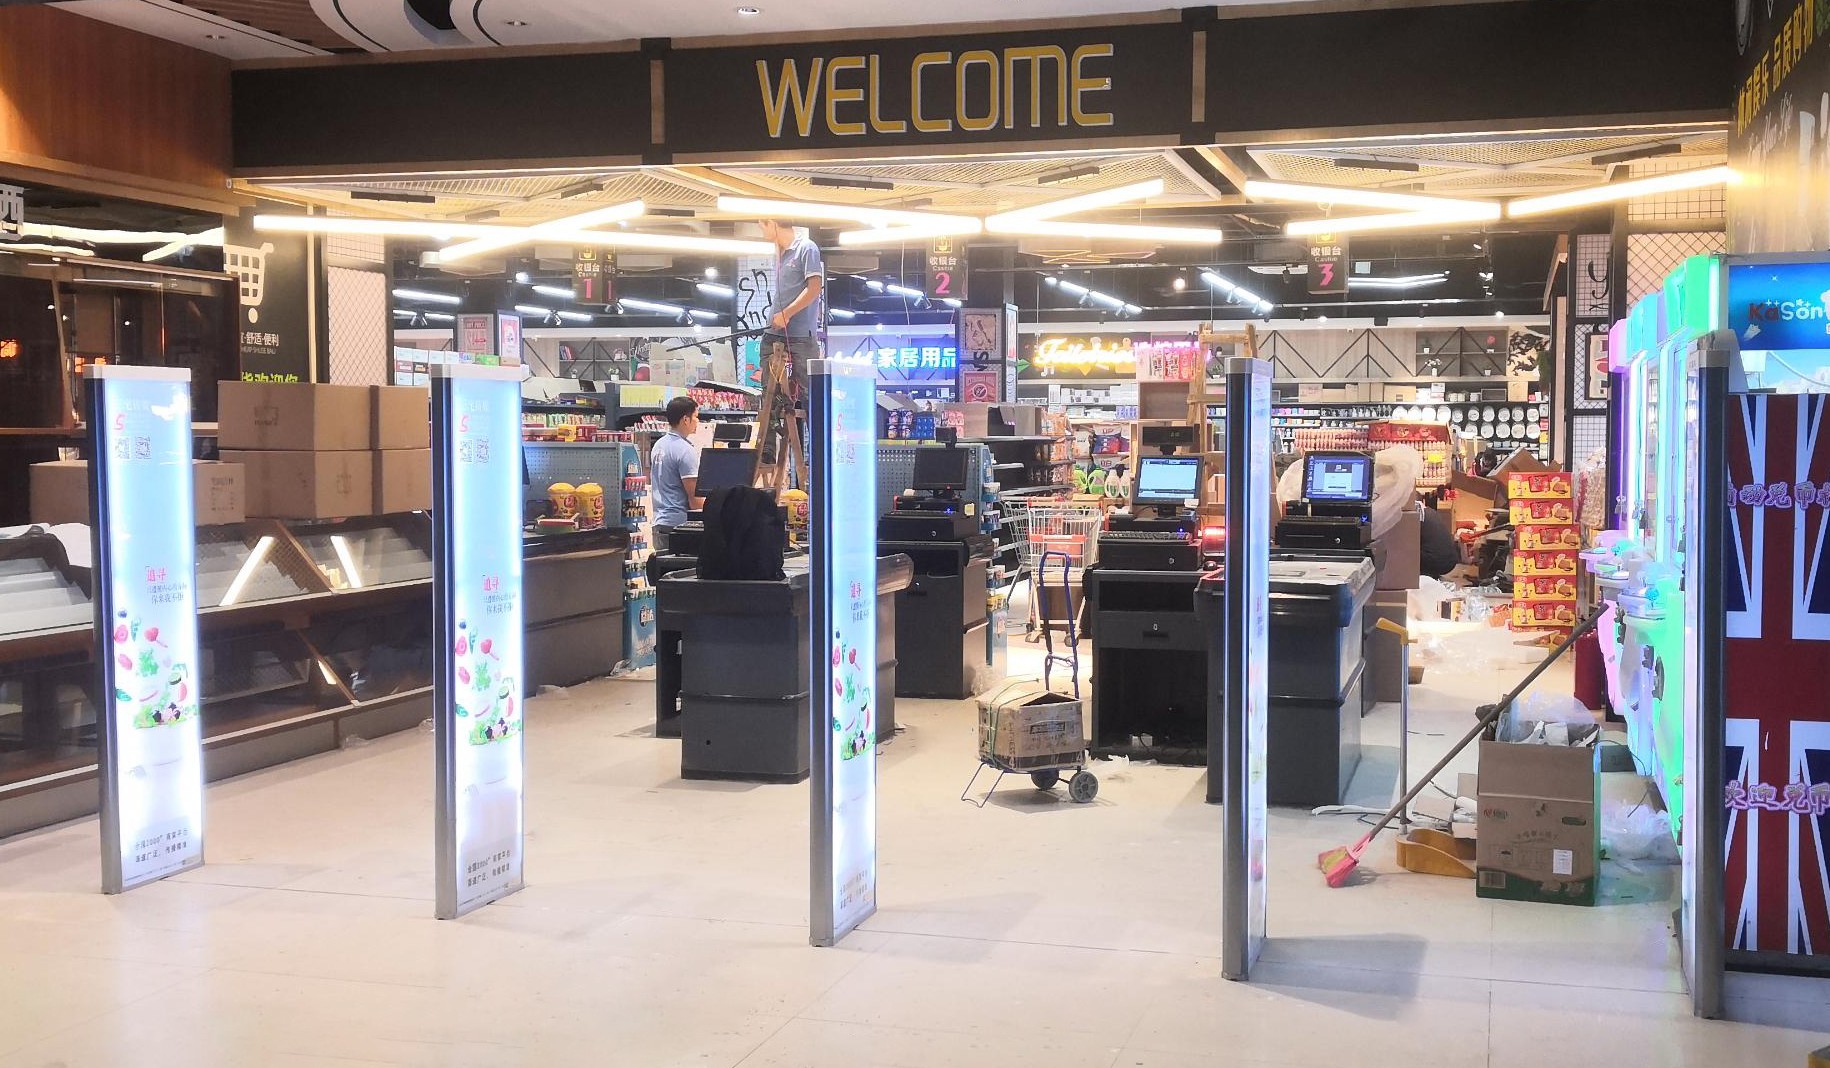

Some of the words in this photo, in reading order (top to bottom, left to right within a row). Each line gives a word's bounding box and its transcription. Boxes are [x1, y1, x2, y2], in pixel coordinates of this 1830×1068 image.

[756, 44, 1114, 138] WELCOME
[935, 271, 950, 294] 2
[1318, 263, 1334, 286] 3
[583, 278, 592, 299] 1
